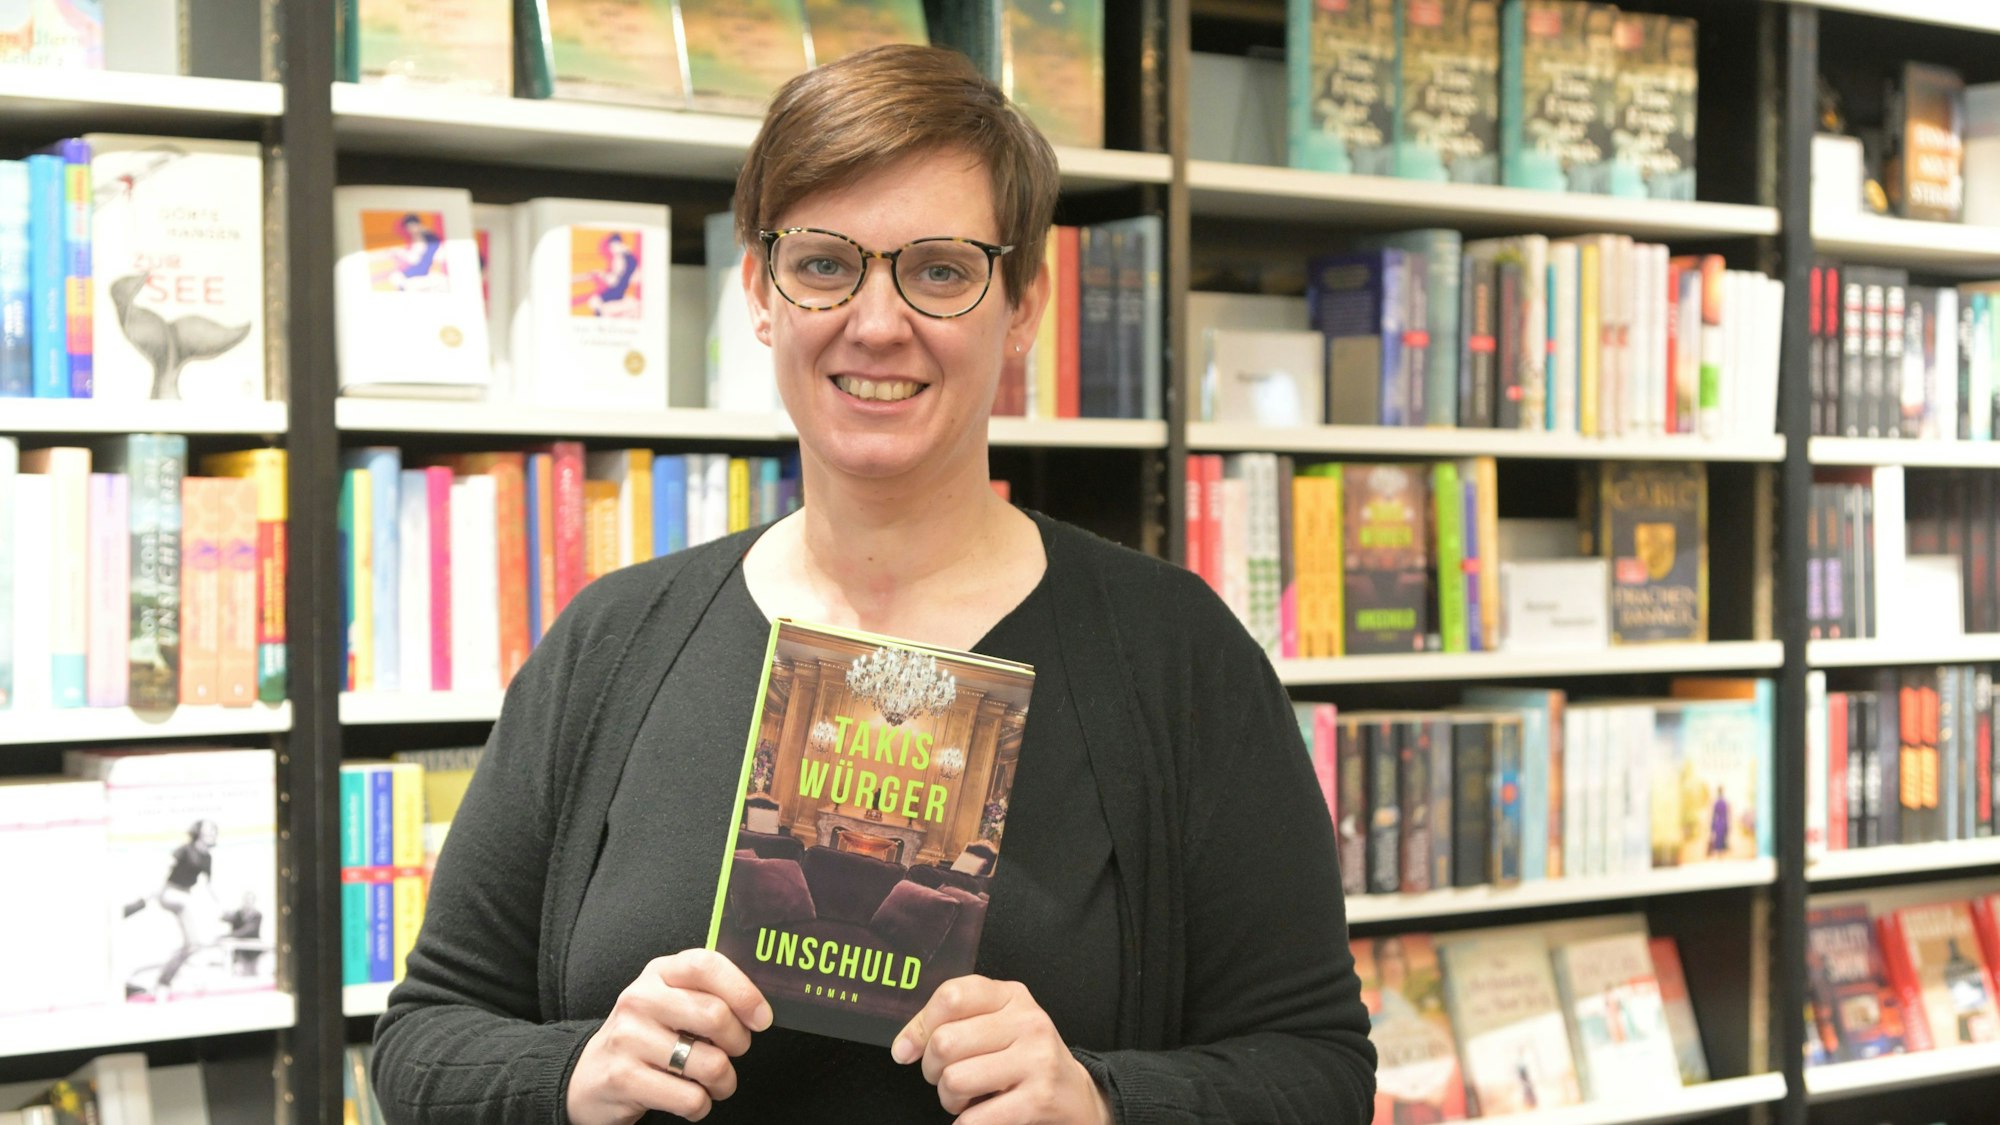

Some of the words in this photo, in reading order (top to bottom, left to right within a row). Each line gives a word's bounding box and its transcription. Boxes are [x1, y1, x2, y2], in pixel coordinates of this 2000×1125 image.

[132, 253, 182, 270] ZUR
[146, 274, 225, 306] SEE
[834, 715, 934, 771] TAKIS
[799, 758, 949, 824] WÜRGER
[755, 927, 922, 990] UNSCHULD
[804, 983, 858, 1004] ROMAN
